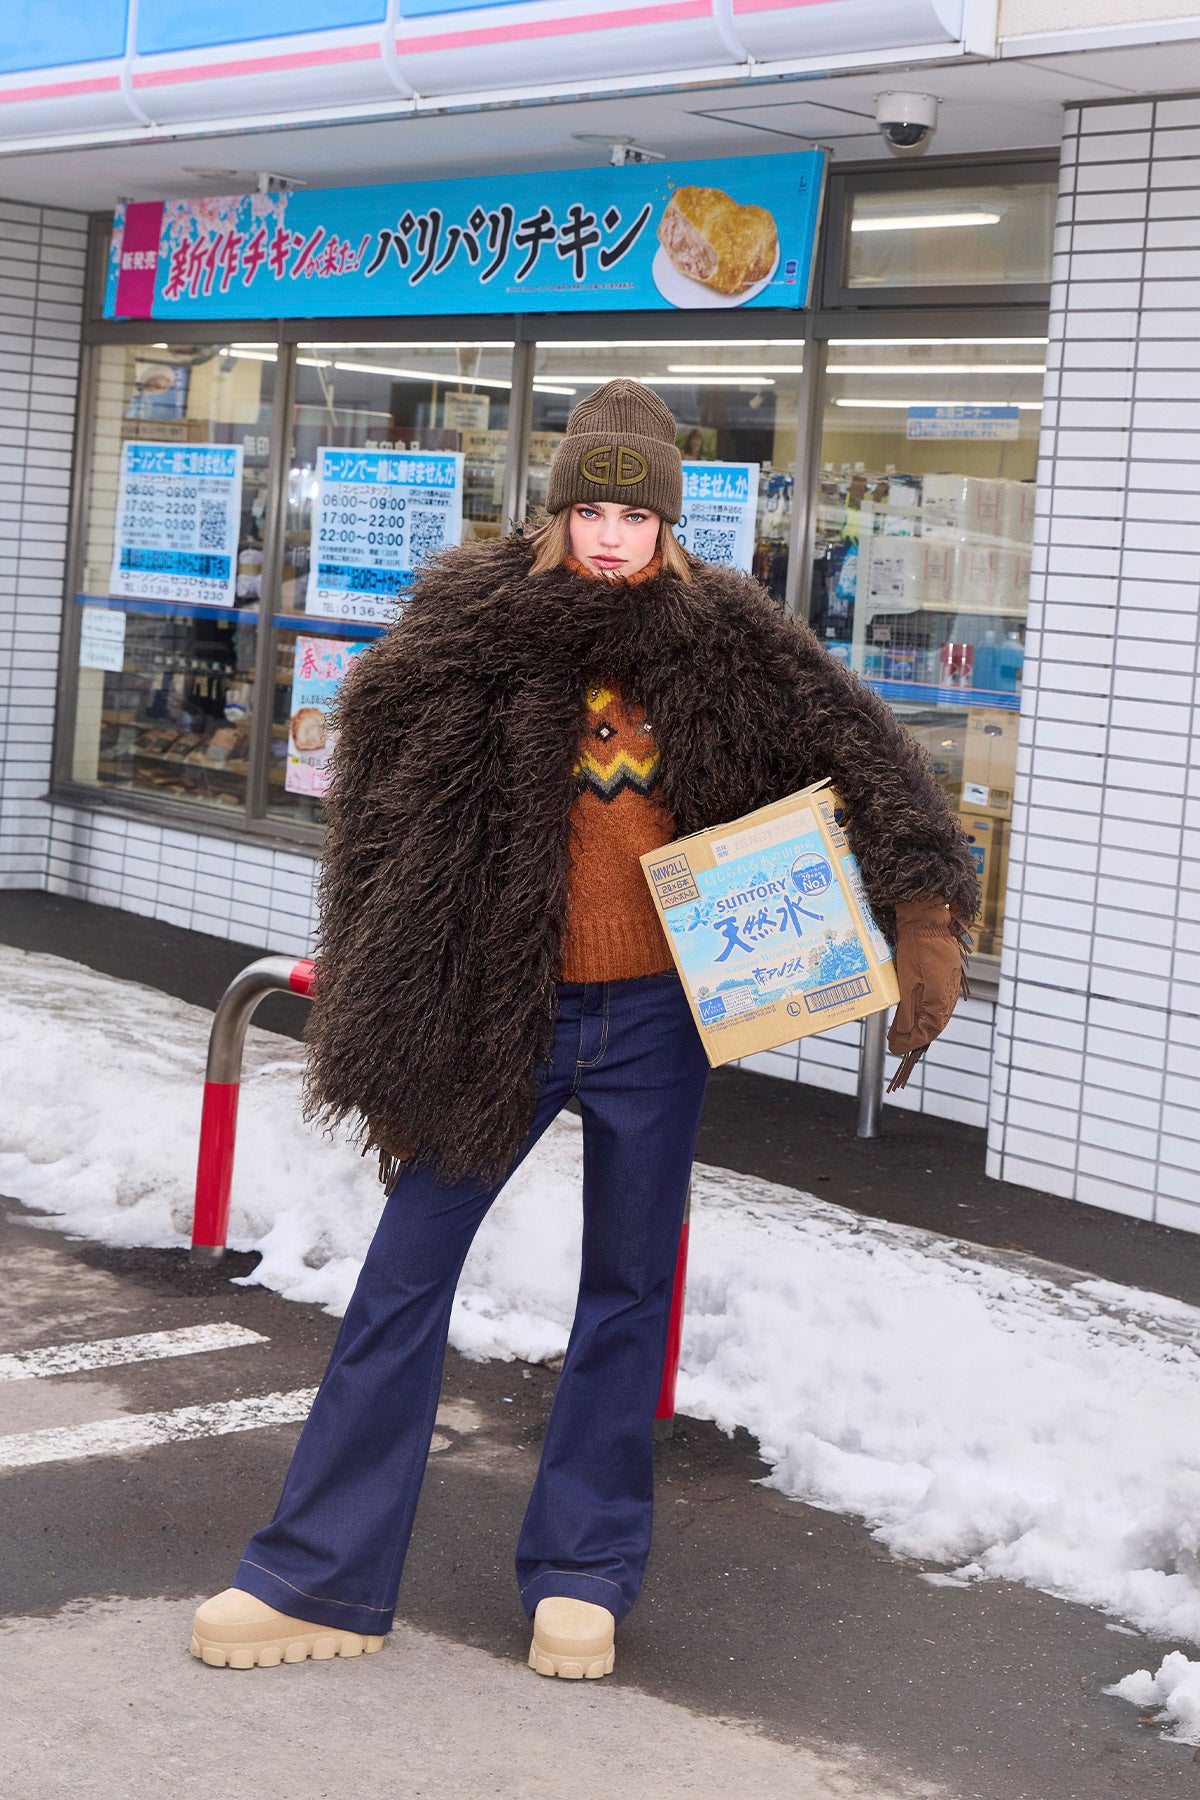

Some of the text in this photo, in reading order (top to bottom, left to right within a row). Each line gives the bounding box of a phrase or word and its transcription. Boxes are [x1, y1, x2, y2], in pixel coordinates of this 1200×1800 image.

[367, 202, 653, 284] パリパリチキン
[323, 459, 455, 485] ローソンで一緒に働きませんか
[653, 860, 688, 881] MW2LL
[803, 874, 828, 892] No.1
[664, 890, 695, 905] ペットボトル
[716, 878, 787, 913] SUNTORY
[713, 894, 825, 962] 天然水
[752, 957, 804, 986] 南アルプス
